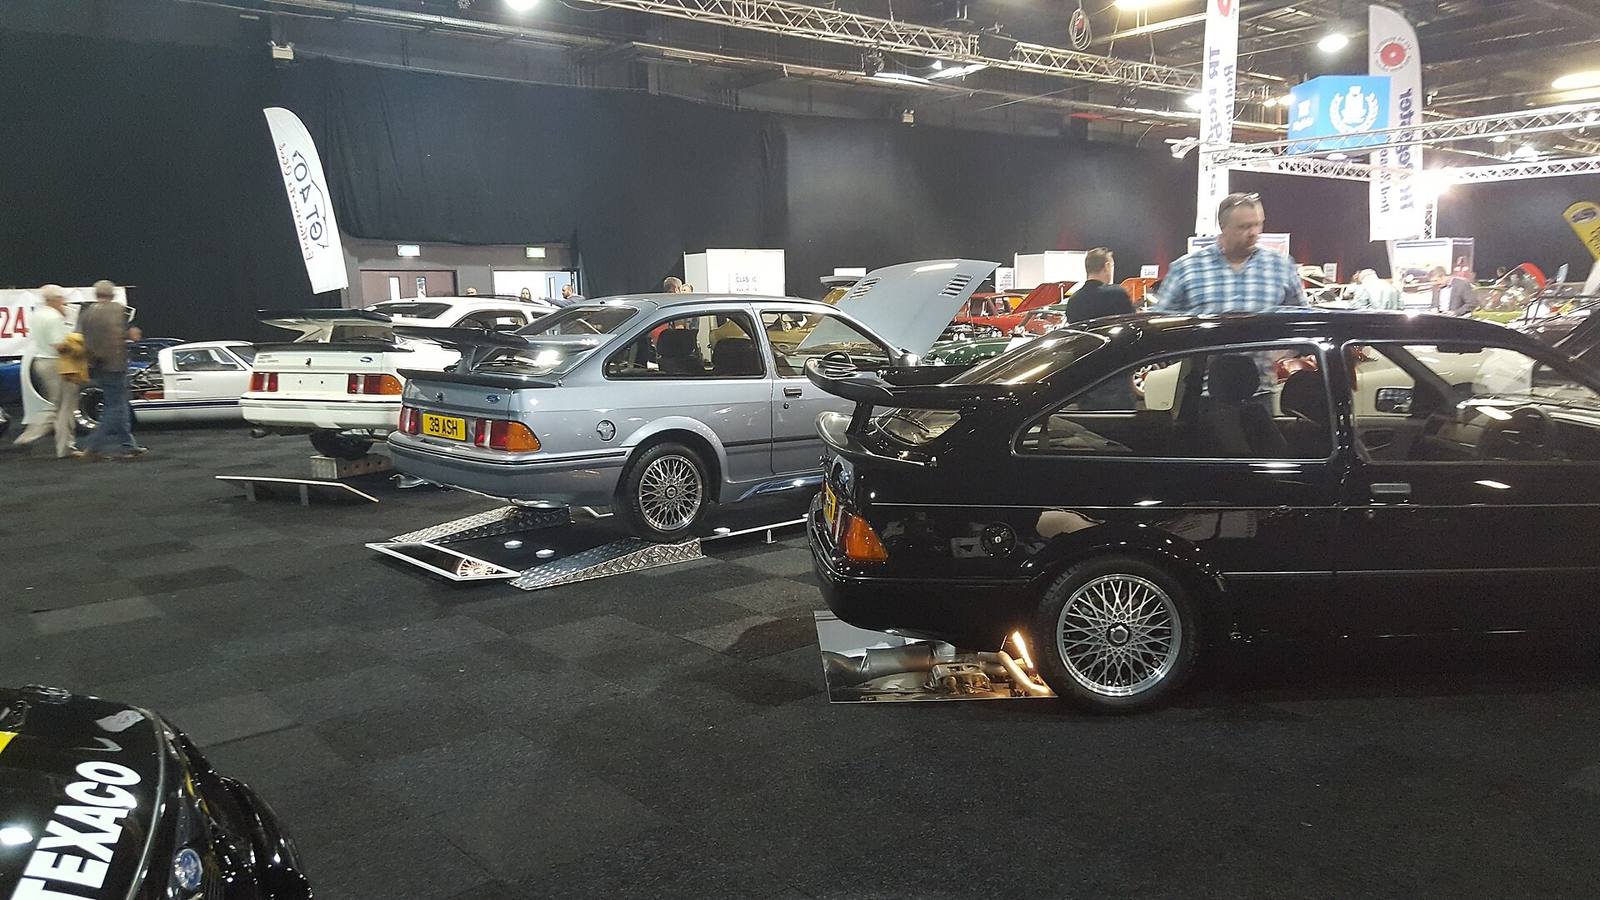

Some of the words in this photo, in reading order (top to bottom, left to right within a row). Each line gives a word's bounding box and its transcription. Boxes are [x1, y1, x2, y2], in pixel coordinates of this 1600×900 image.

[429, 416, 440, 433] 39
[442, 419, 457, 436] ASH
[10, 760, 142, 900] TEXACO
